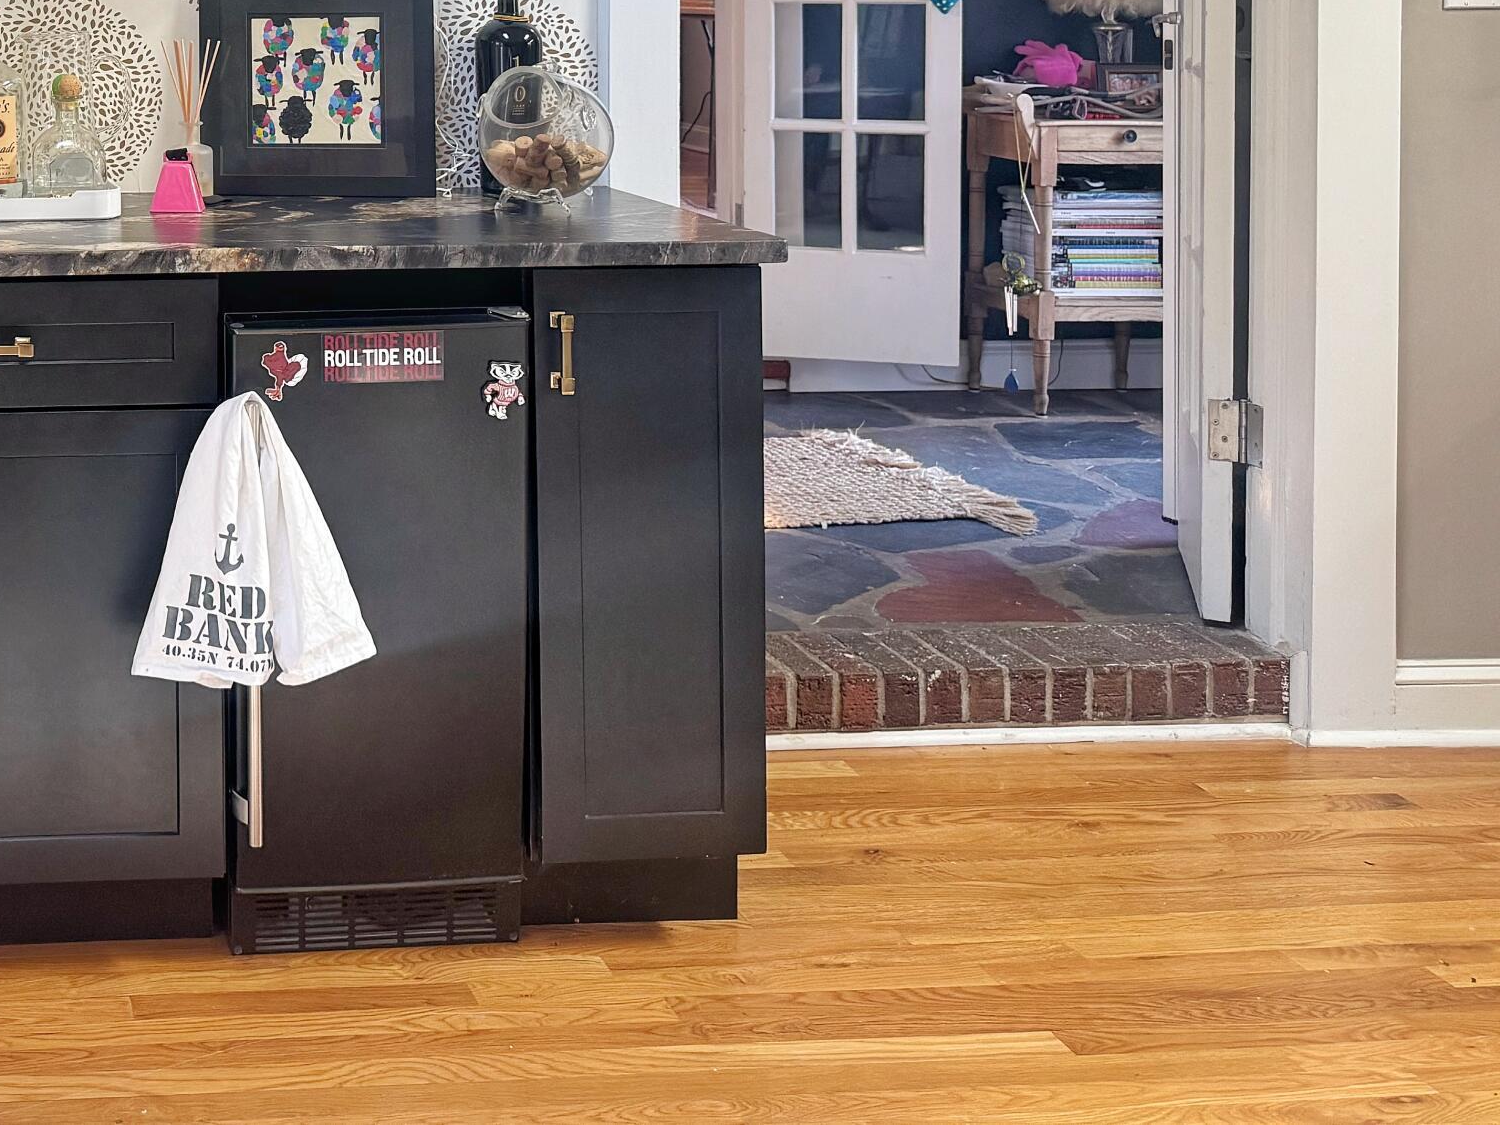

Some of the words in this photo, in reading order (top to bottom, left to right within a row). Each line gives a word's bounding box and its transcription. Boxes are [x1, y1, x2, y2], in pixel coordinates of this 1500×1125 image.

[324, 349, 362, 368] ROLL
[363, 348, 401, 367] TIDE
[404, 346, 442, 366] ROLL
[185, 573, 266, 620] RED
[162, 605, 274, 655] BANK
[162, 643, 219, 665] 40.35N
